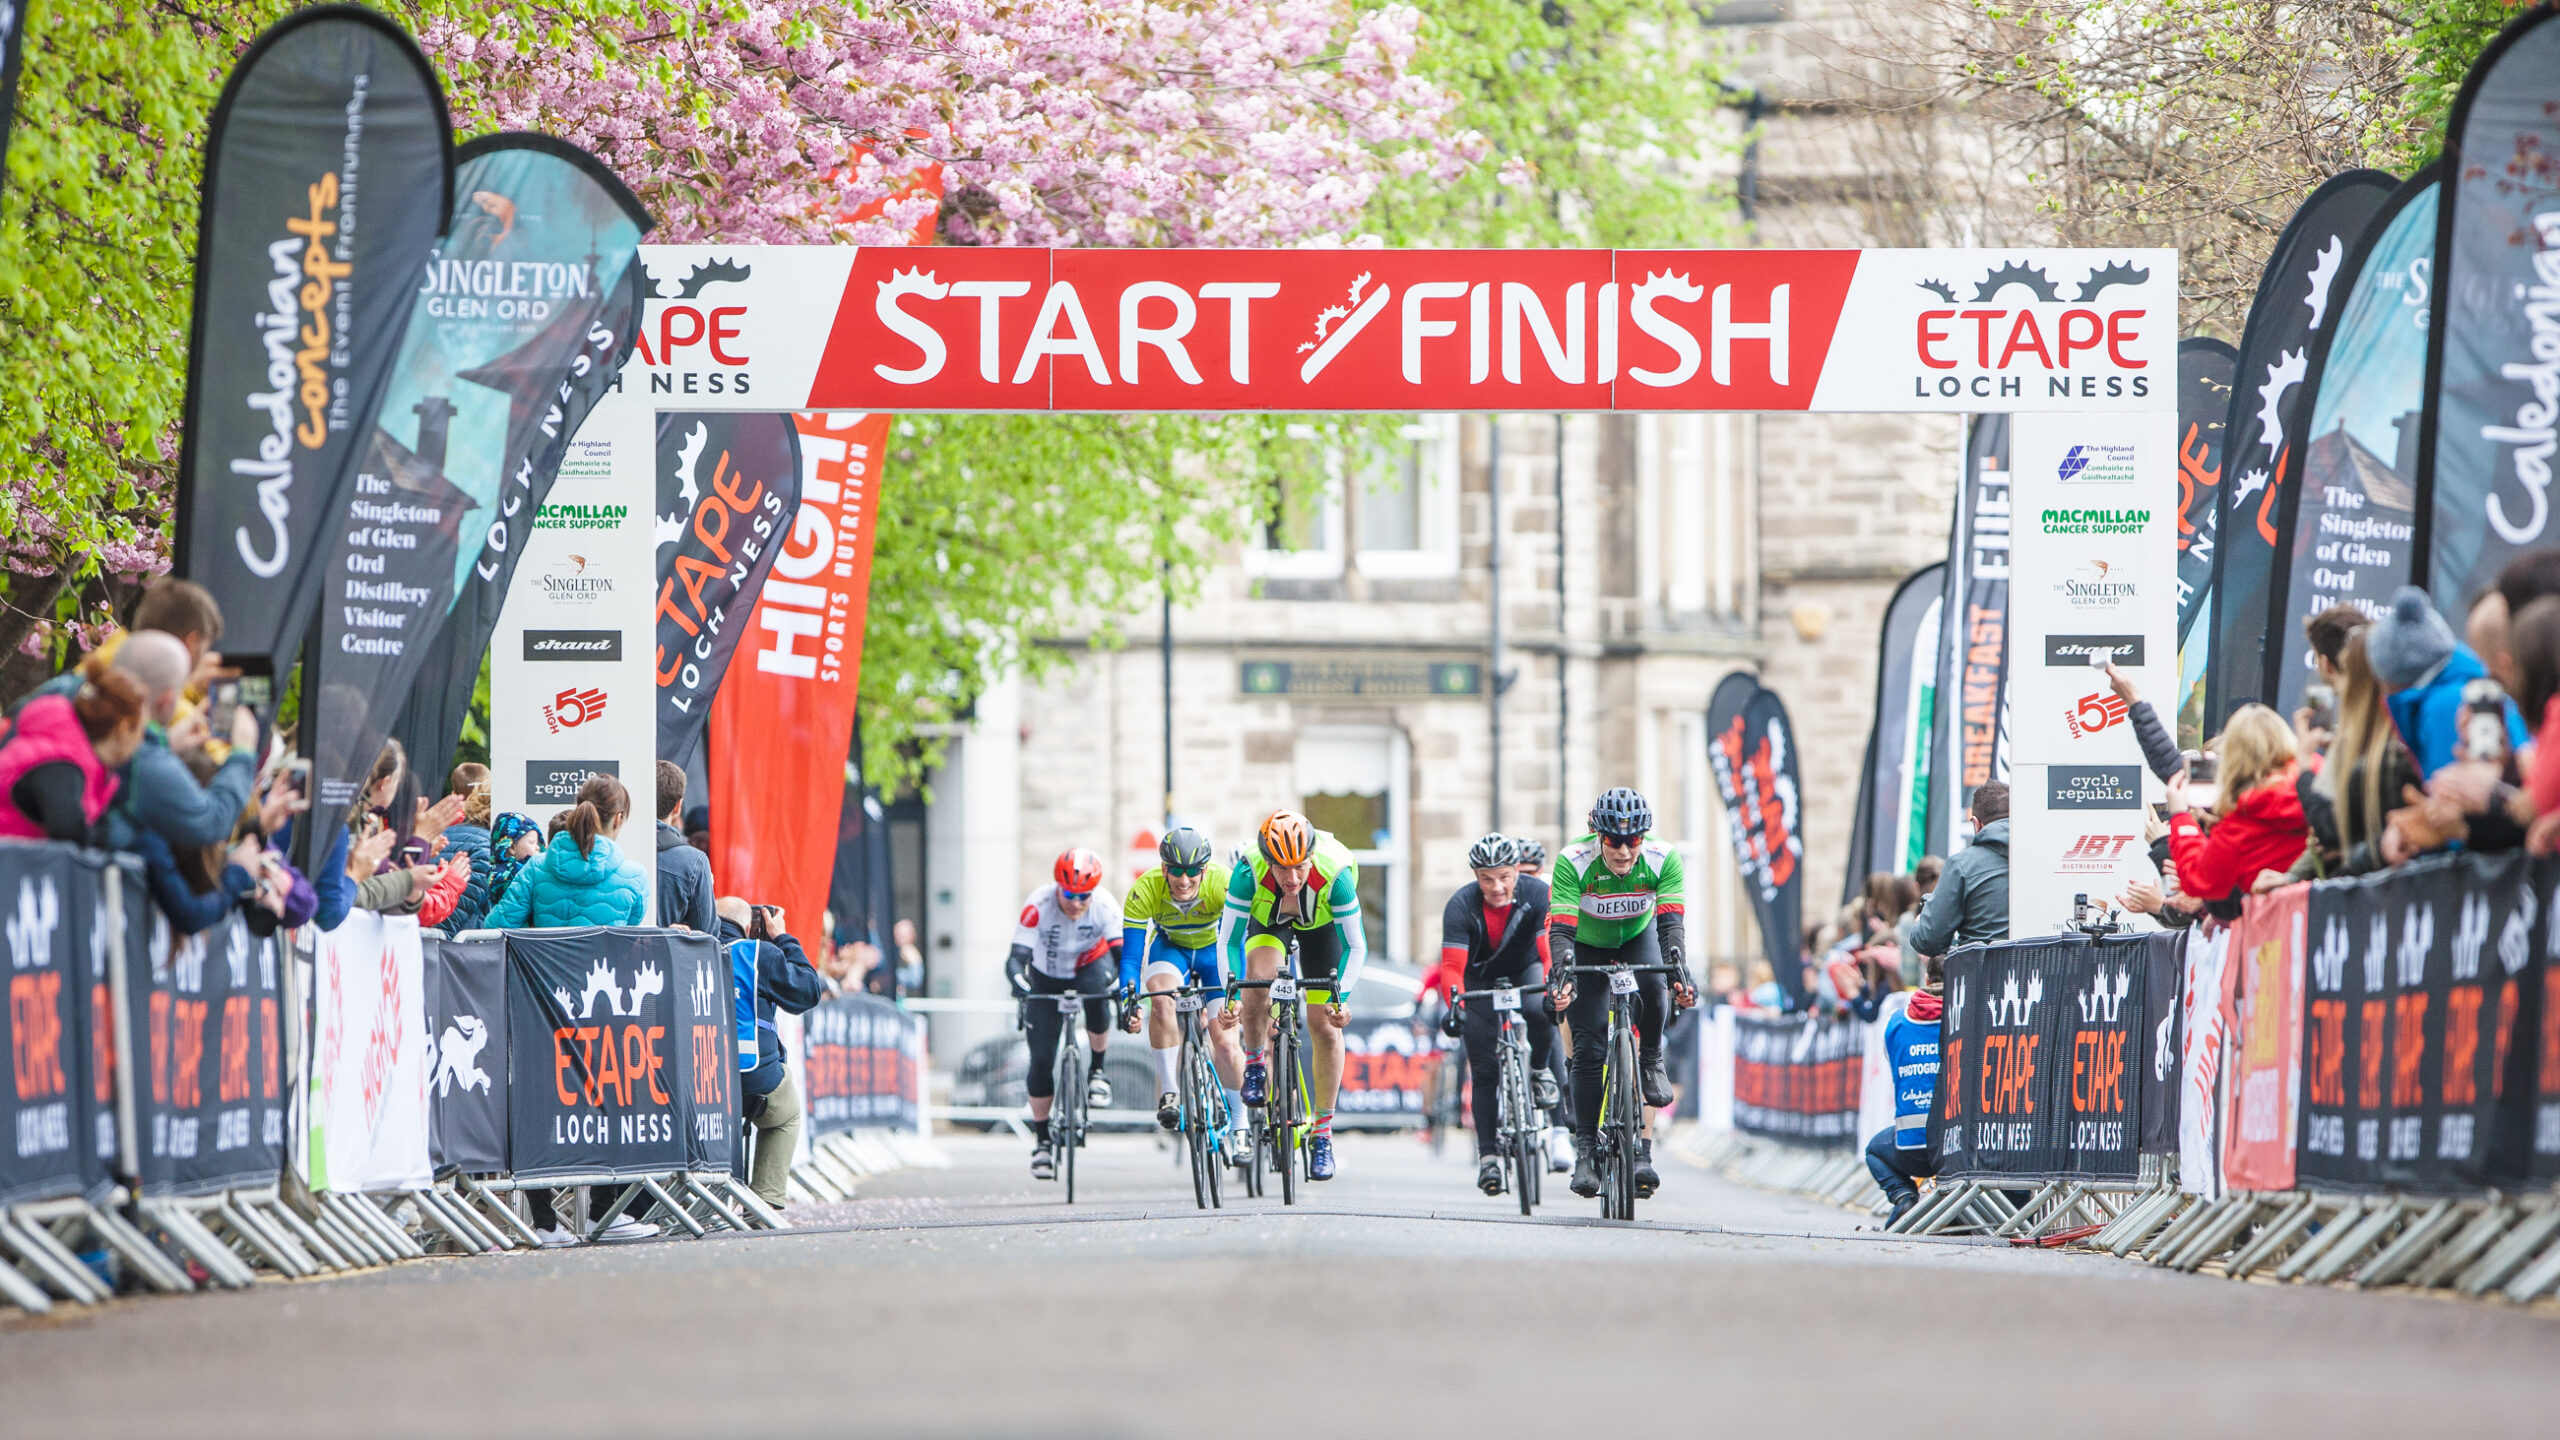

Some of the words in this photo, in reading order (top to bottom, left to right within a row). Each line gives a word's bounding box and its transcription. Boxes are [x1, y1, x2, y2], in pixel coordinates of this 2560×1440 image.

[335, 73, 370, 261] Frontrunners
[287, 171, 353, 450] concepts
[427, 297, 489, 319] GLEN
[497, 299, 551, 321] ORD
[330, 281, 352, 368] Event
[874, 265, 1281, 386] START
[1401, 267, 1790, 387] FINISH
[1917, 309, 2148, 369] ETAPE
[651, 372, 750, 394] NESS
[1915, 376, 2021, 397] LOCH
[2049, 376, 2149, 397] NESS
[230, 237, 304, 577] Caledonian
[328, 377, 350, 432] The
[578, 441, 611, 449] Highland
[2101, 445, 2135, 453] Highland
[355, 473, 391, 495] The
[2323, 485, 2365, 510] The
[349, 499, 442, 526] Singleton
[536, 504, 628, 519] ACMILLAN
[834, 442, 869, 578] NUTRITION
[2041, 509, 2151, 524] MACMILLAN
[569, 519, 621, 529] SUPPORT
[2043, 524, 2089, 534] CANCER
[2091, 524, 2144, 534] SUPPORT
[348, 526, 372, 547] of
[371, 527, 417, 550] Glen
[757, 413, 868, 680] HIGH
[346, 552, 386, 575] Ord
[2315, 541, 2342, 562] of
[2341, 542, 2391, 568] Glen
[543, 574, 613, 592] SINGLETON
[2066, 579, 2136, 597] SINGLETON
[2313, 567, 2356, 592] Ord
[345, 579, 431, 608] Distillery
[548, 592, 573, 600] GLEN
[576, 592, 598, 600] ORD
[671, 605, 725, 714] LOCH
[730, 490, 783, 592] NESS
[2071, 597, 2096, 605] GLEN
[2099, 597, 2121, 605] ORD
[343, 605, 406, 629] Visitor
[341, 633, 404, 656] Centre
[533, 639, 612, 651] shand
[821, 592, 850, 683] SPORTS
[1963, 603, 2003, 787] BREAKFAST
[542, 704, 560, 735] HIGH
[2064, 709, 2082, 740] HIGH
[534, 782, 584, 797] repub
[2071, 773, 2120, 788] cycle
[2056, 787, 2134, 803] republic
[2062, 835, 2136, 858] JBT
[1597, 899, 1647, 914] DEESIDE
[1275, 984, 1293, 995] 443
[1614, 978, 1632, 988] 545
[1909, 1043, 1939, 1057] OFFICI
[553, 1024, 669, 1107] ETAPE
[1981, 1034, 2040, 1115] ETAPE
[2072, 1029, 2127, 1113] ETAPE
[555, 1113, 609, 1144] LOCH
[620, 1113, 672, 1144] NESS
[1977, 1122, 2004, 1150] LOCH
[2007, 1122, 2032, 1150] NESS
